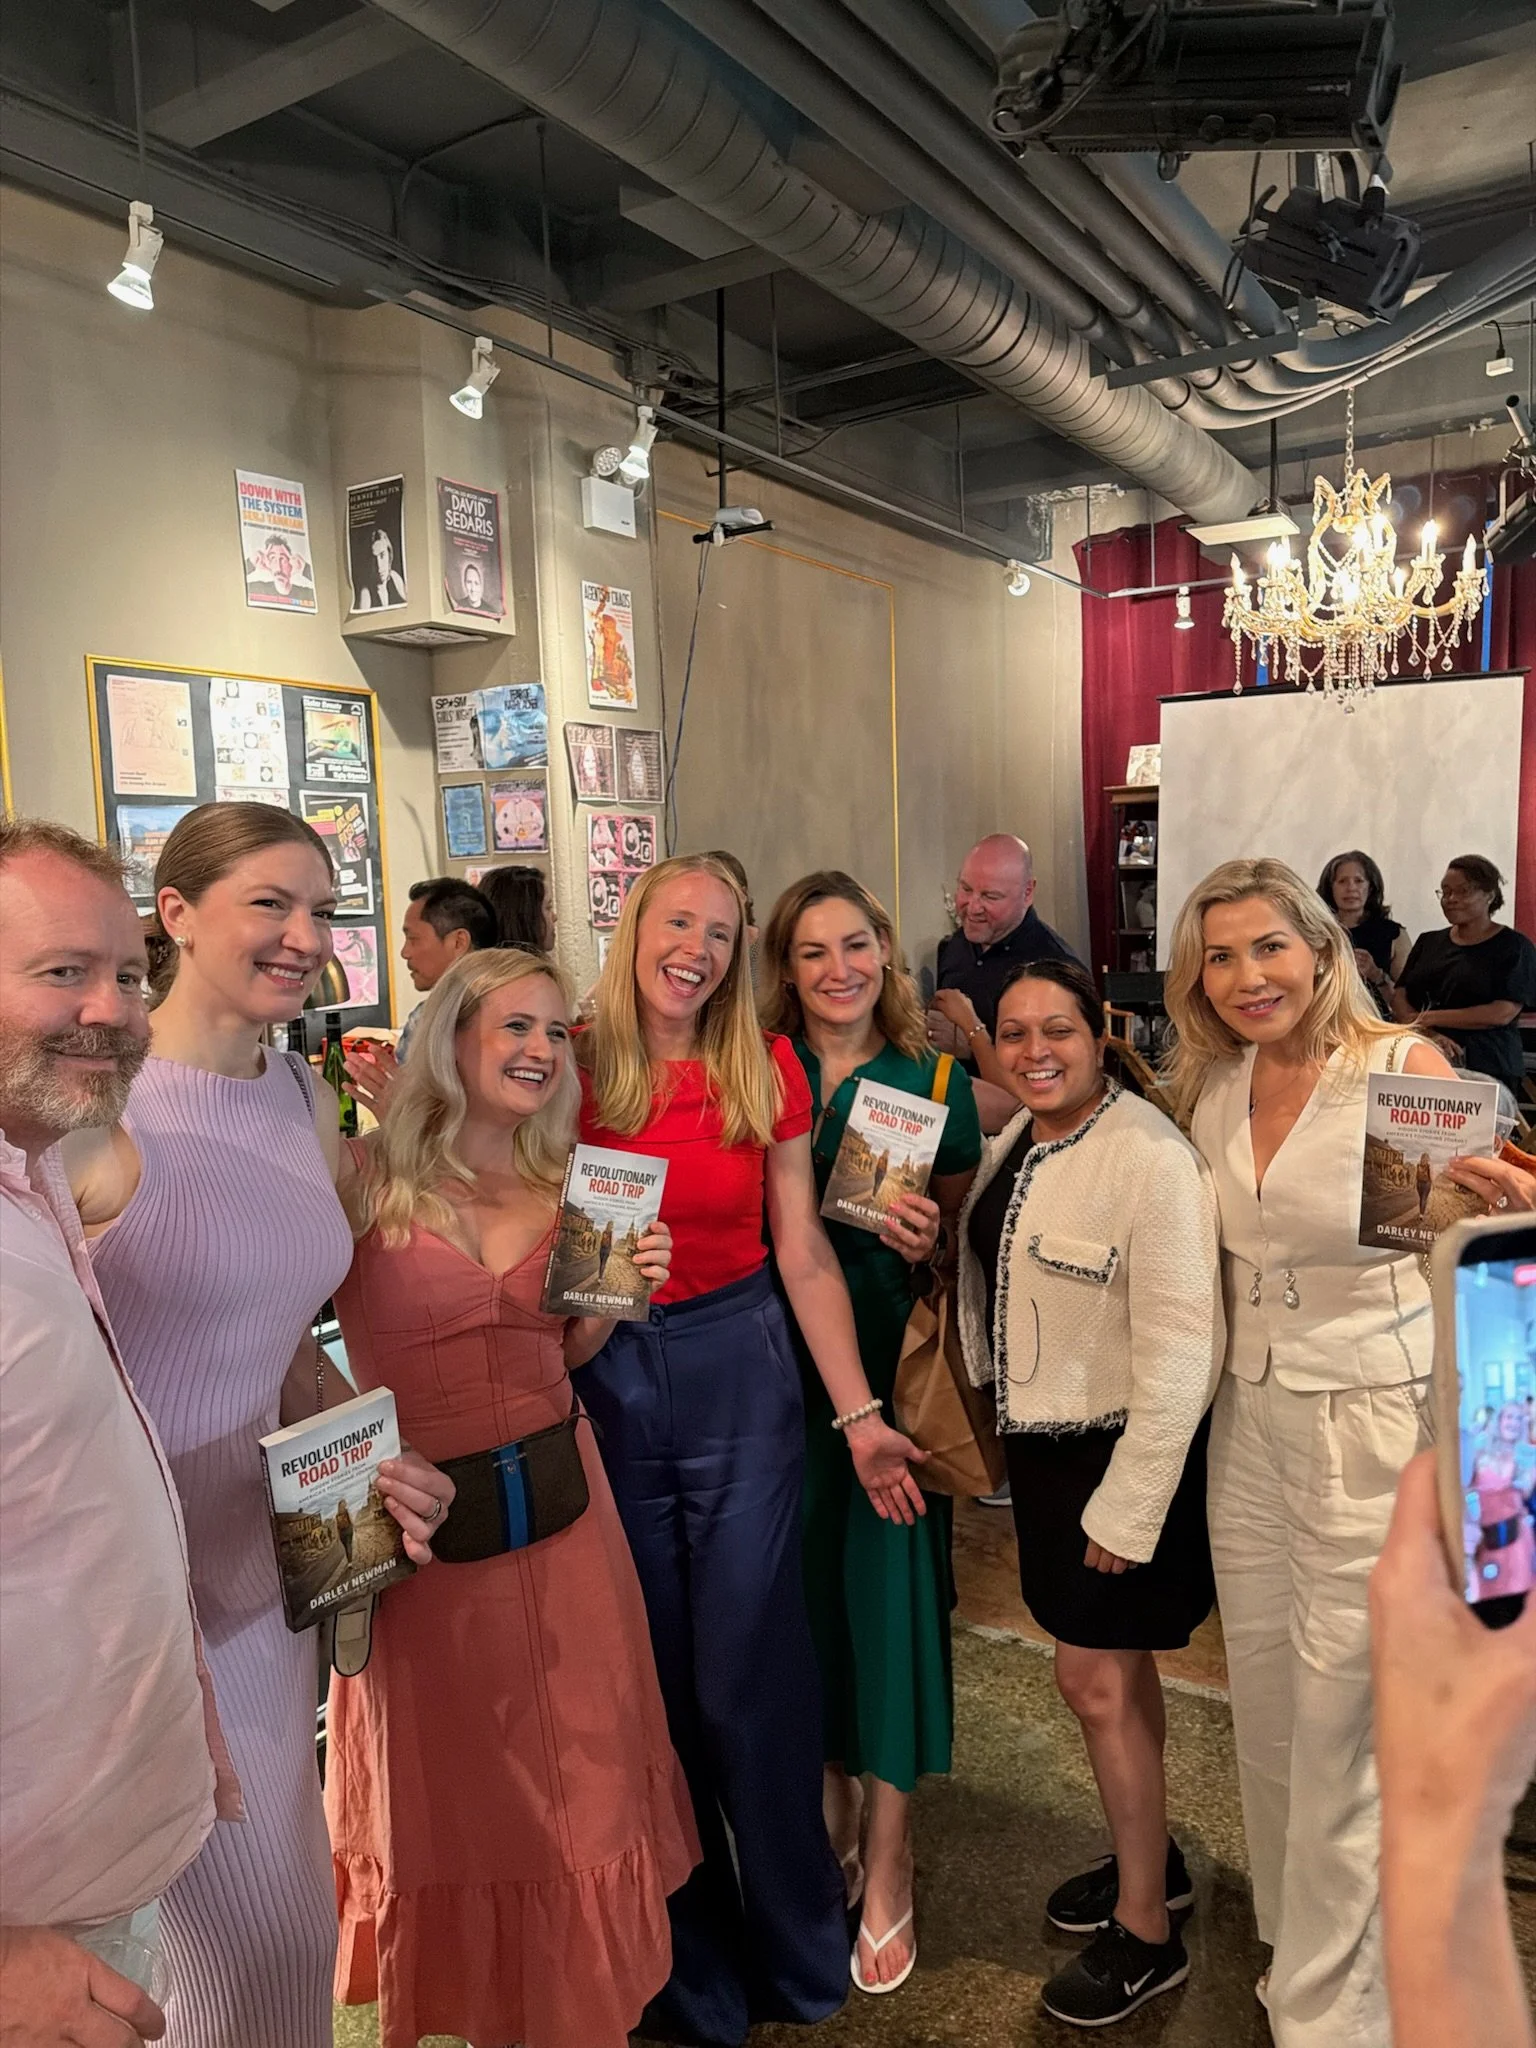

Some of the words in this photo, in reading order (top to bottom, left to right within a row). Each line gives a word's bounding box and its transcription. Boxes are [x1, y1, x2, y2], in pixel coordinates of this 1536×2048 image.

[240, 482, 272, 500] DOWN
[275, 489, 302, 506] WITH
[451, 494, 486, 518] DAVID
[241, 496, 262, 511] THE
[264, 501, 303, 519] SYSTEM
[445, 509, 494, 537] SEDARIS
[862, 1094, 936, 1128] REVOLUTIONARY
[1377, 1092, 1482, 1116] REVOLUTIONARY
[868, 1109, 898, 1129] ROAD
[900, 1119, 923, 1136] TRIP
[1390, 1108, 1430, 1126] ROAD
[1434, 1112, 1467, 1130] TRIP
[580, 1163, 658, 1187] REVOLUTIONARY
[589, 1178, 620, 1196] ROAD
[622, 1183, 645, 1199] TRIP
[836, 1198, 867, 1216] DARLEY
[1377, 1225, 1417, 1238] DARLEY
[1419, 1229, 1441, 1241] NEW
[563, 1291, 594, 1302] DARLEY
[595, 1294, 634, 1306] NEWMAN
[281, 1418, 384, 1478] REVOLUTIONARY
[298, 1457, 340, 1489] ROAD
[341, 1440, 373, 1468] TRIP
[310, 1581, 349, 1610] DARLEY
[351, 1557, 397, 1588] NEWMAN
